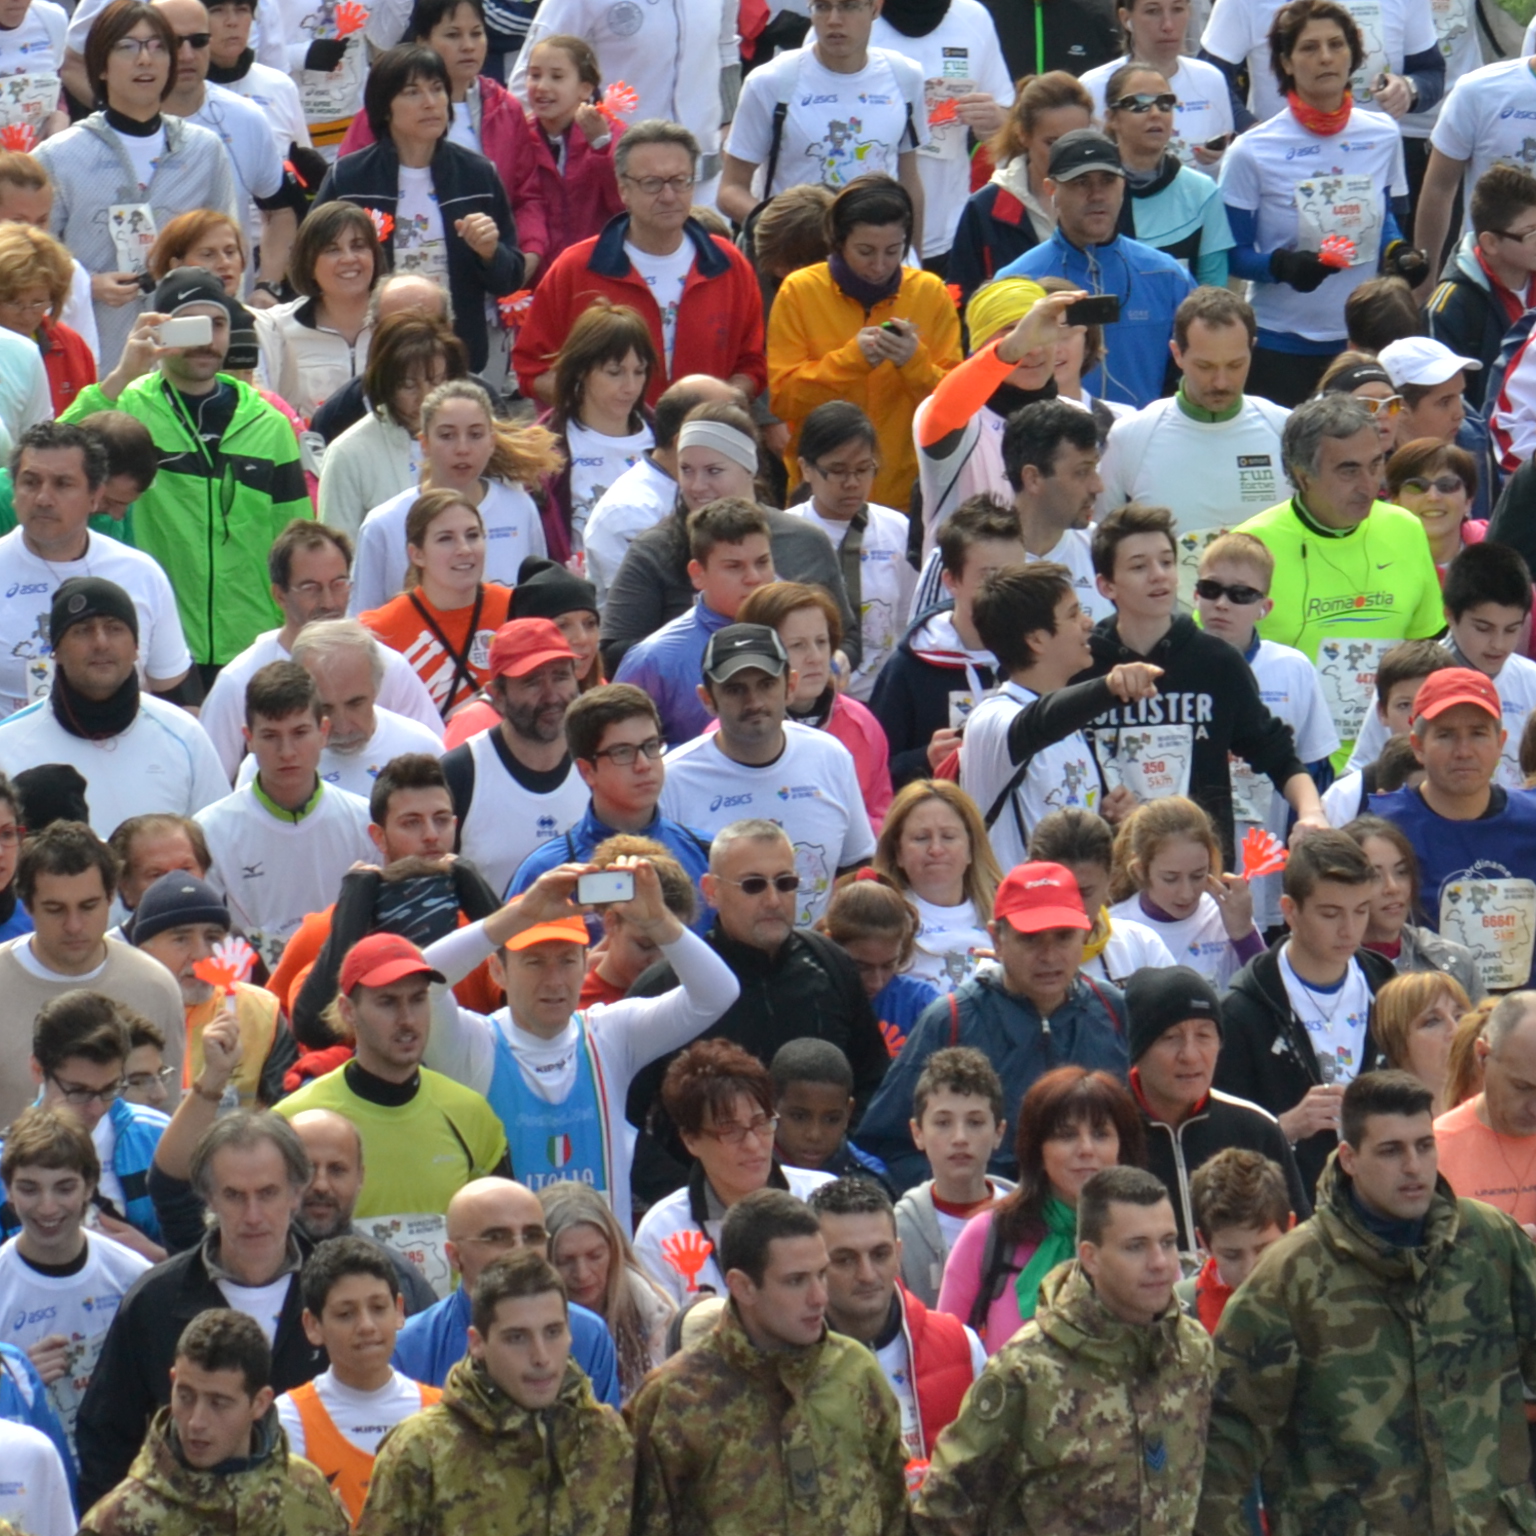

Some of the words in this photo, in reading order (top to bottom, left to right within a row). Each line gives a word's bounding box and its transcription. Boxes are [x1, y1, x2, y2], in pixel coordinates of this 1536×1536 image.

[1239, 470, 1273, 481] run
[21, 583, 48, 594] asics
[1143, 761, 1166, 774] 350
[723, 793, 752, 806] asics
[26, 1307, 56, 1324] asics
